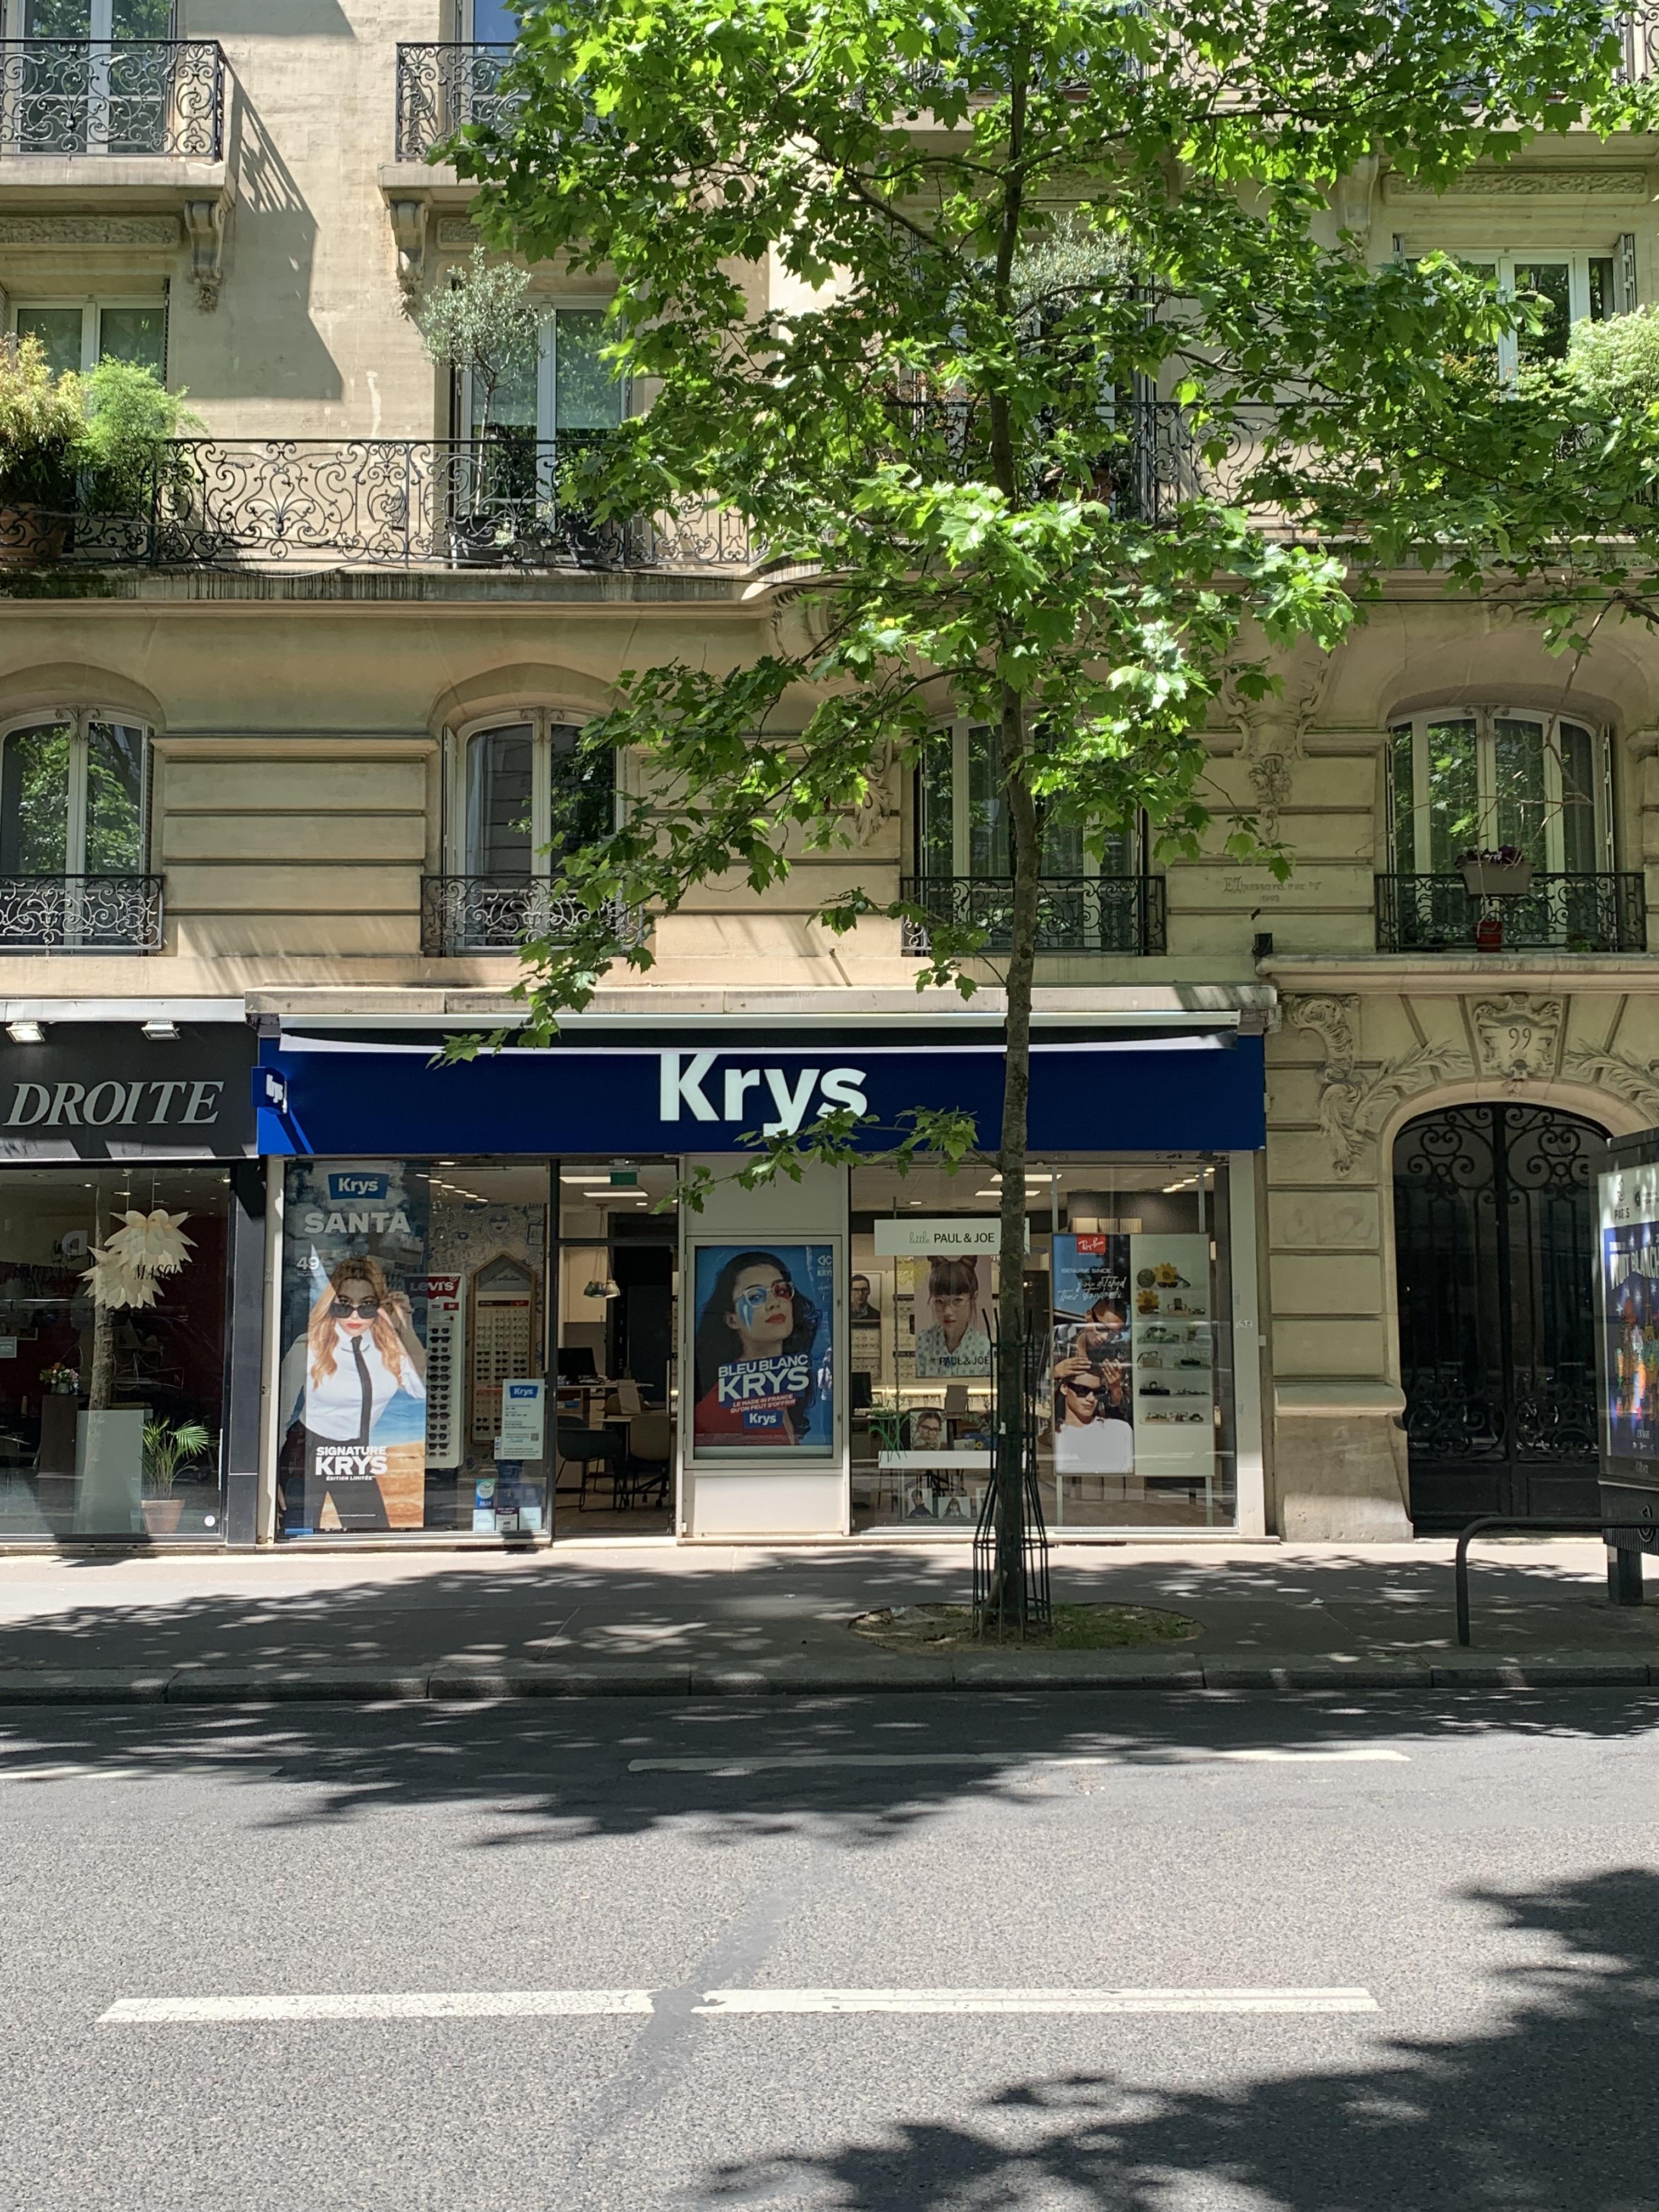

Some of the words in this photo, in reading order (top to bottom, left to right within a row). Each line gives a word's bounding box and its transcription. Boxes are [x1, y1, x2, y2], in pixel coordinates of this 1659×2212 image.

[1508, 1027, 1532, 1050] 99
[3, 1081, 224, 1126] DROITE
[660, 1053, 868, 1137] Krys
[338, 1177, 379, 1195] Krys
[304, 1212, 411, 1234] SANTA
[1615, 1207, 1630, 1220] PARS
[909, 1231, 930, 1244] little
[934, 1233, 962, 1243] PAUL
[963, 1233, 972, 1243] &
[974, 1233, 995, 1243] JOE
[718, 1362, 757, 1378] BLEU
[759, 1354, 809, 1370] BLANC
[514, 1387, 534, 1397] Krys
[718, 1365, 809, 1402] KRYS
[768, 1394, 793, 1402] FRANCE
[749, 1413, 777, 1426] Krys
[316, 1446, 387, 1455] SIGNATURE
[315, 1455, 388, 1475] KRYS
